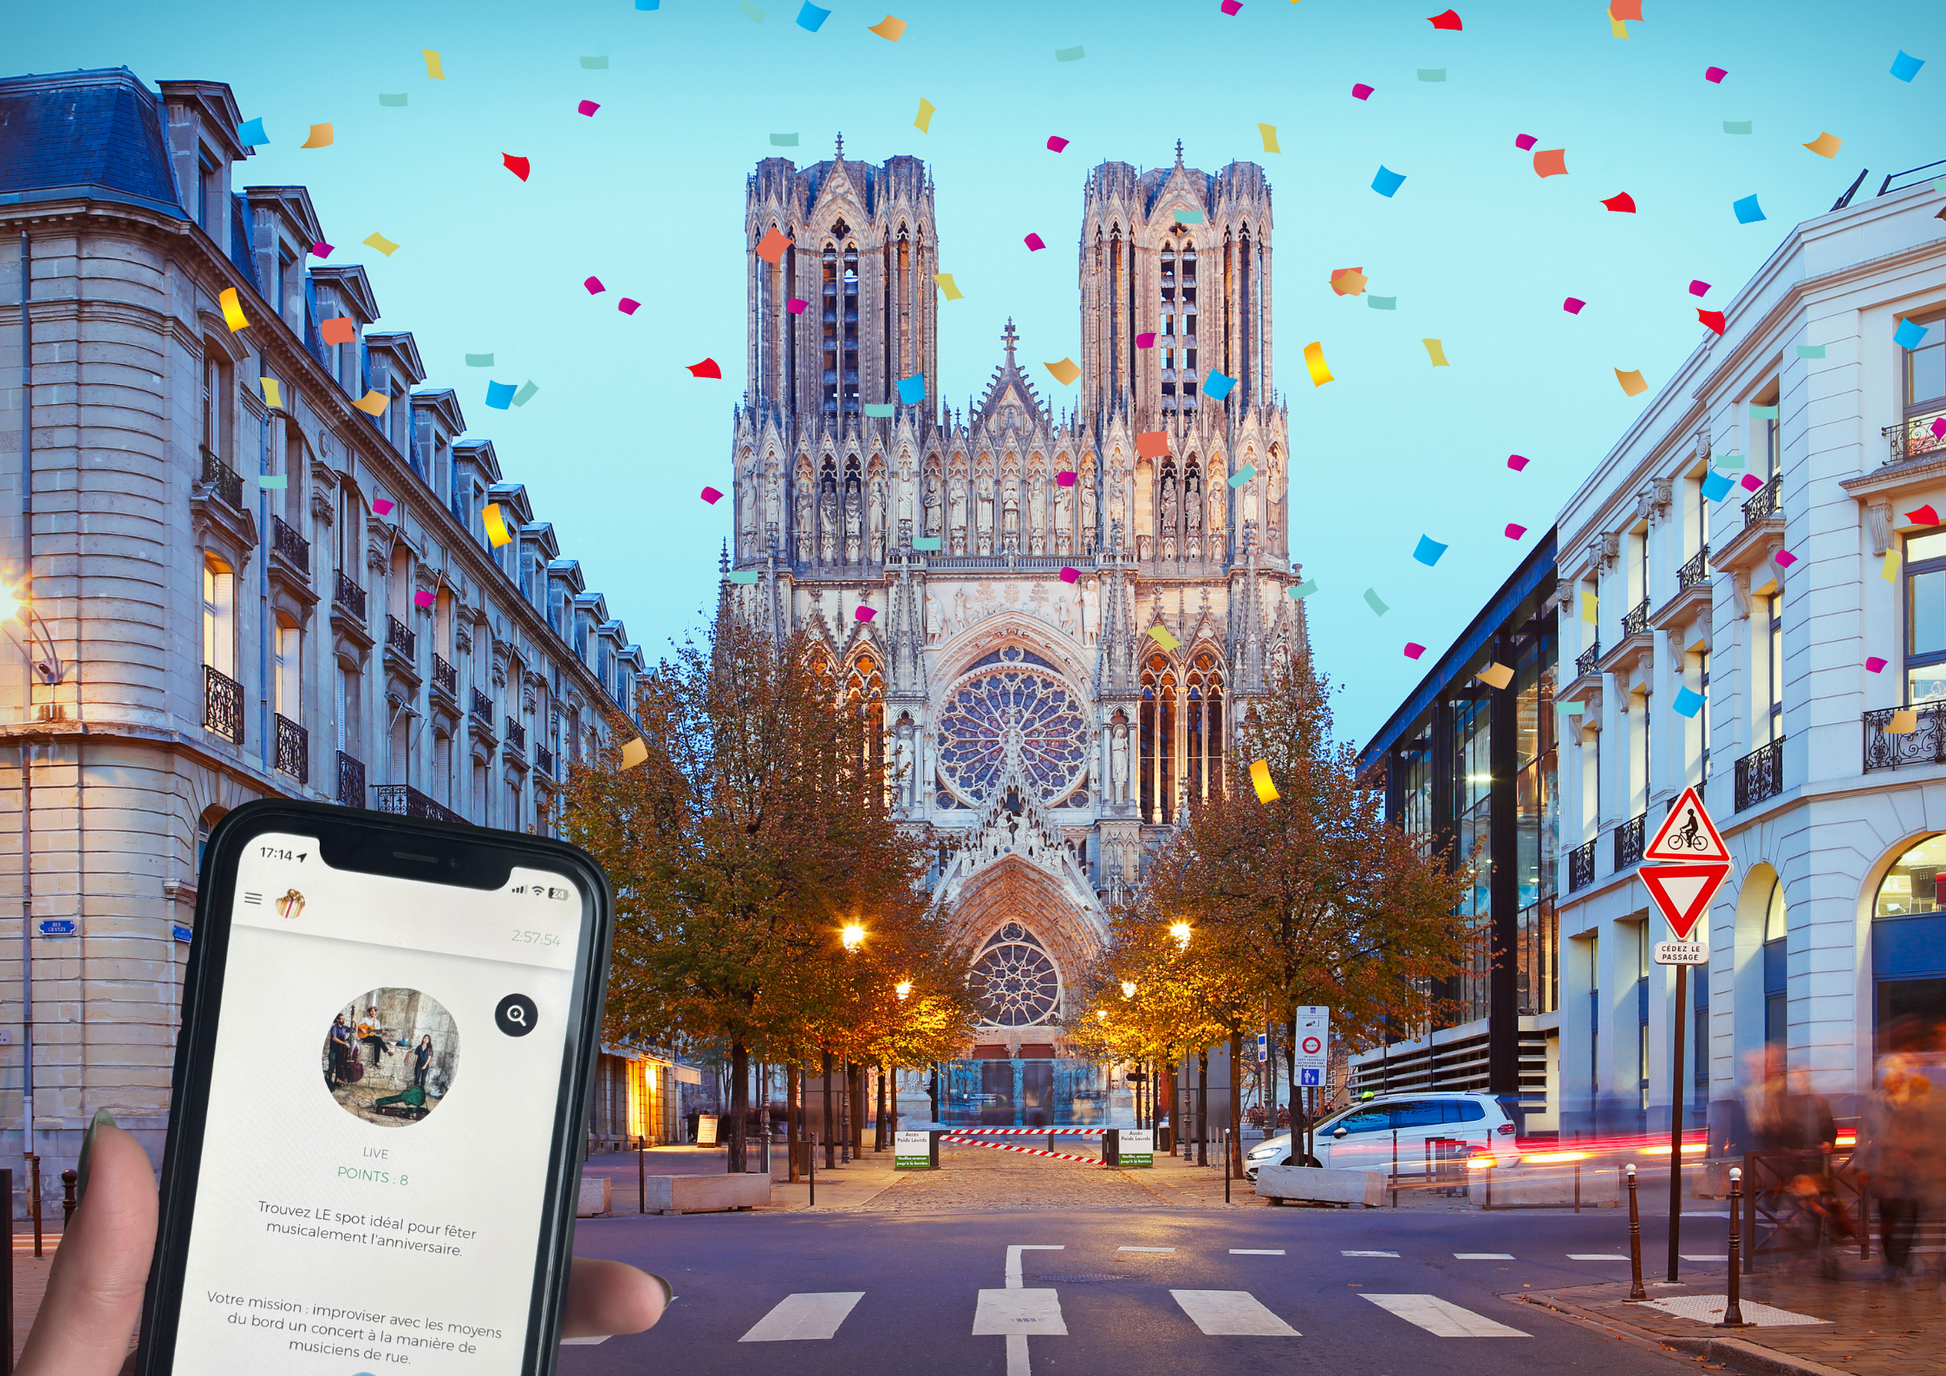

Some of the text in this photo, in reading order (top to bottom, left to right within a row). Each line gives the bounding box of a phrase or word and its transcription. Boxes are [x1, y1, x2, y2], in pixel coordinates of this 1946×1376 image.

[260, 846, 292, 861] 17:14
[551, 889, 565, 900] 24
[511, 929, 561, 947] 2:57:54
[1661, 944, 1687, 952] CÉDEZ
[1662, 953, 1699, 961] PASSAGE
[363, 1146, 389, 1160] LIVE
[338, 1166, 389, 1183] POINTS
[400, 1174, 408, 1186] 8
[258, 1200, 477, 1239] Trouvez LE spot idéal pour fêter
[266, 1222, 462, 1256] musicalement l'anniversaire.
[207, 1290, 244, 1306] Votre
[248, 1297, 302, 1313] mission
[312, 1303, 386, 1324] improviser
[390, 1316, 421, 1328] avec
[425, 1317, 443, 1331] les
[448, 1323, 502, 1339] moyens
[227, 1312, 476, 1354] du bord un concert à la manière de
[289, 1340, 411, 1364] musiciens de rue.
